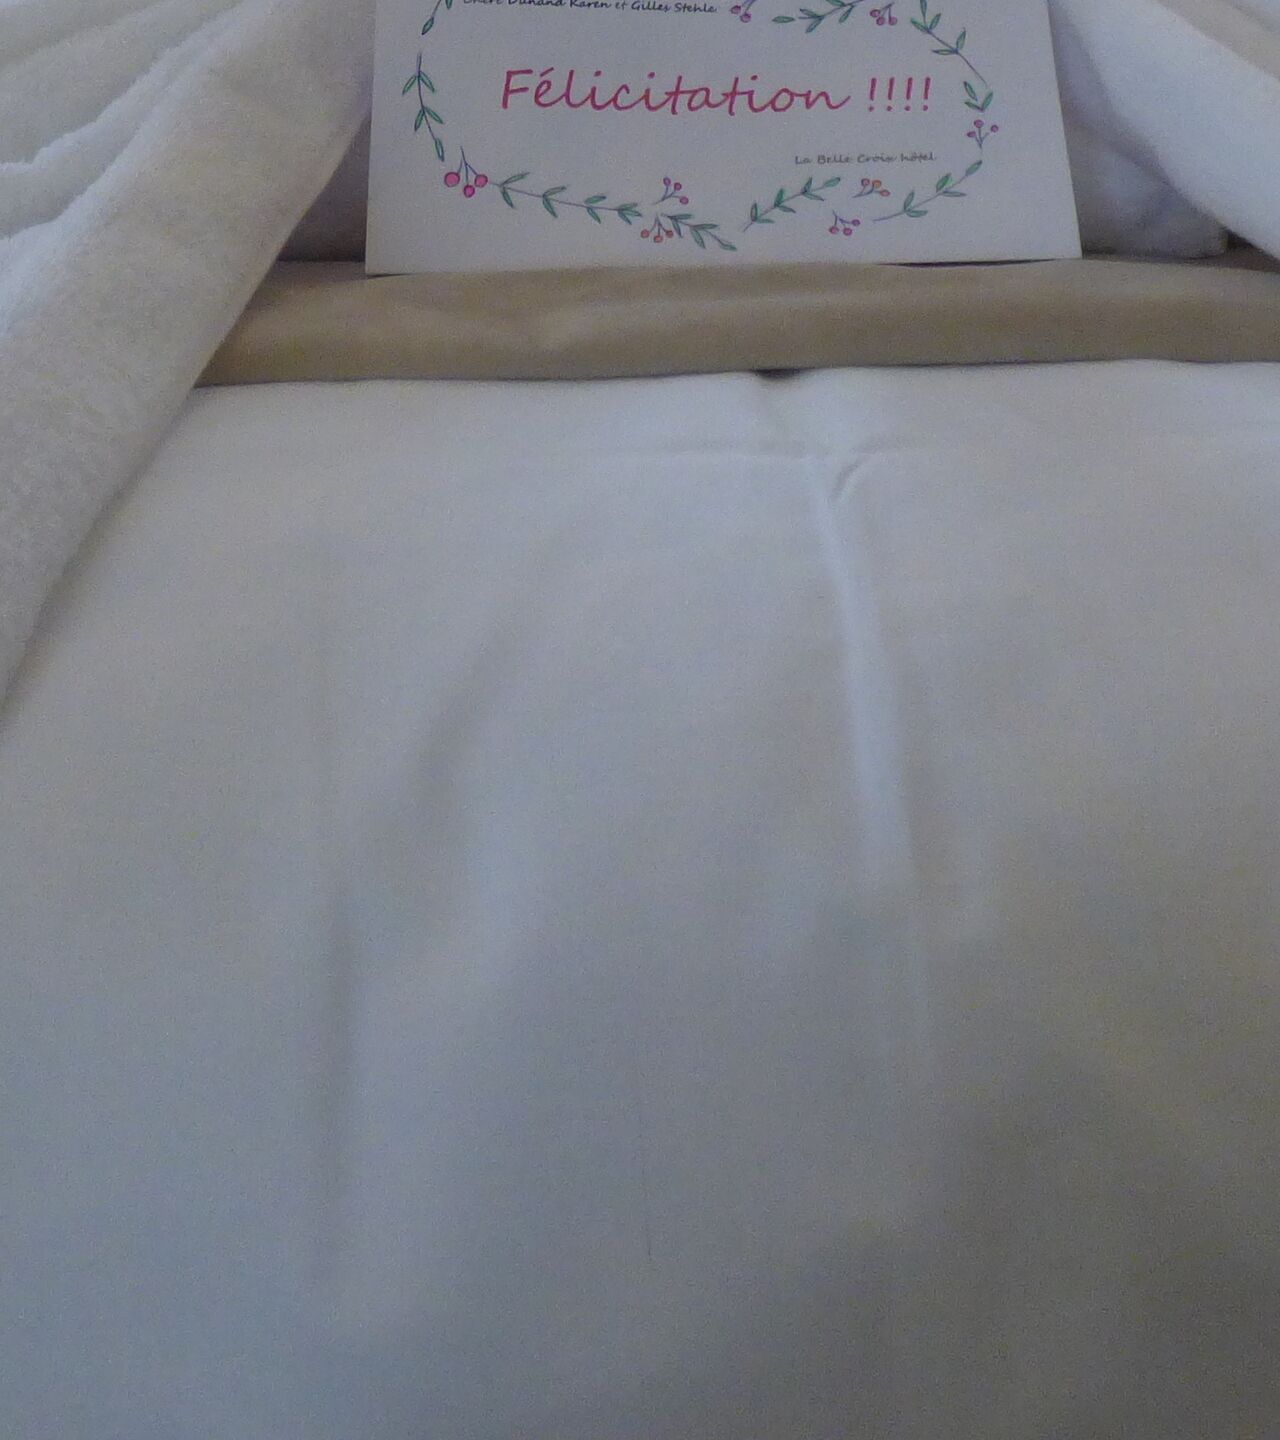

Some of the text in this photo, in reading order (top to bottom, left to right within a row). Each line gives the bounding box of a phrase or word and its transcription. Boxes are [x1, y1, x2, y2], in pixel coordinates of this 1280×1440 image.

[615, 0, 628, 10] et
[631, 0, 671, 13] Gilles
[500, 66, 933, 117] Félicitation !!!!
[794, 155, 811, 165] La
[817, 154, 852, 165] Belle
[857, 153, 898, 164] Croix
